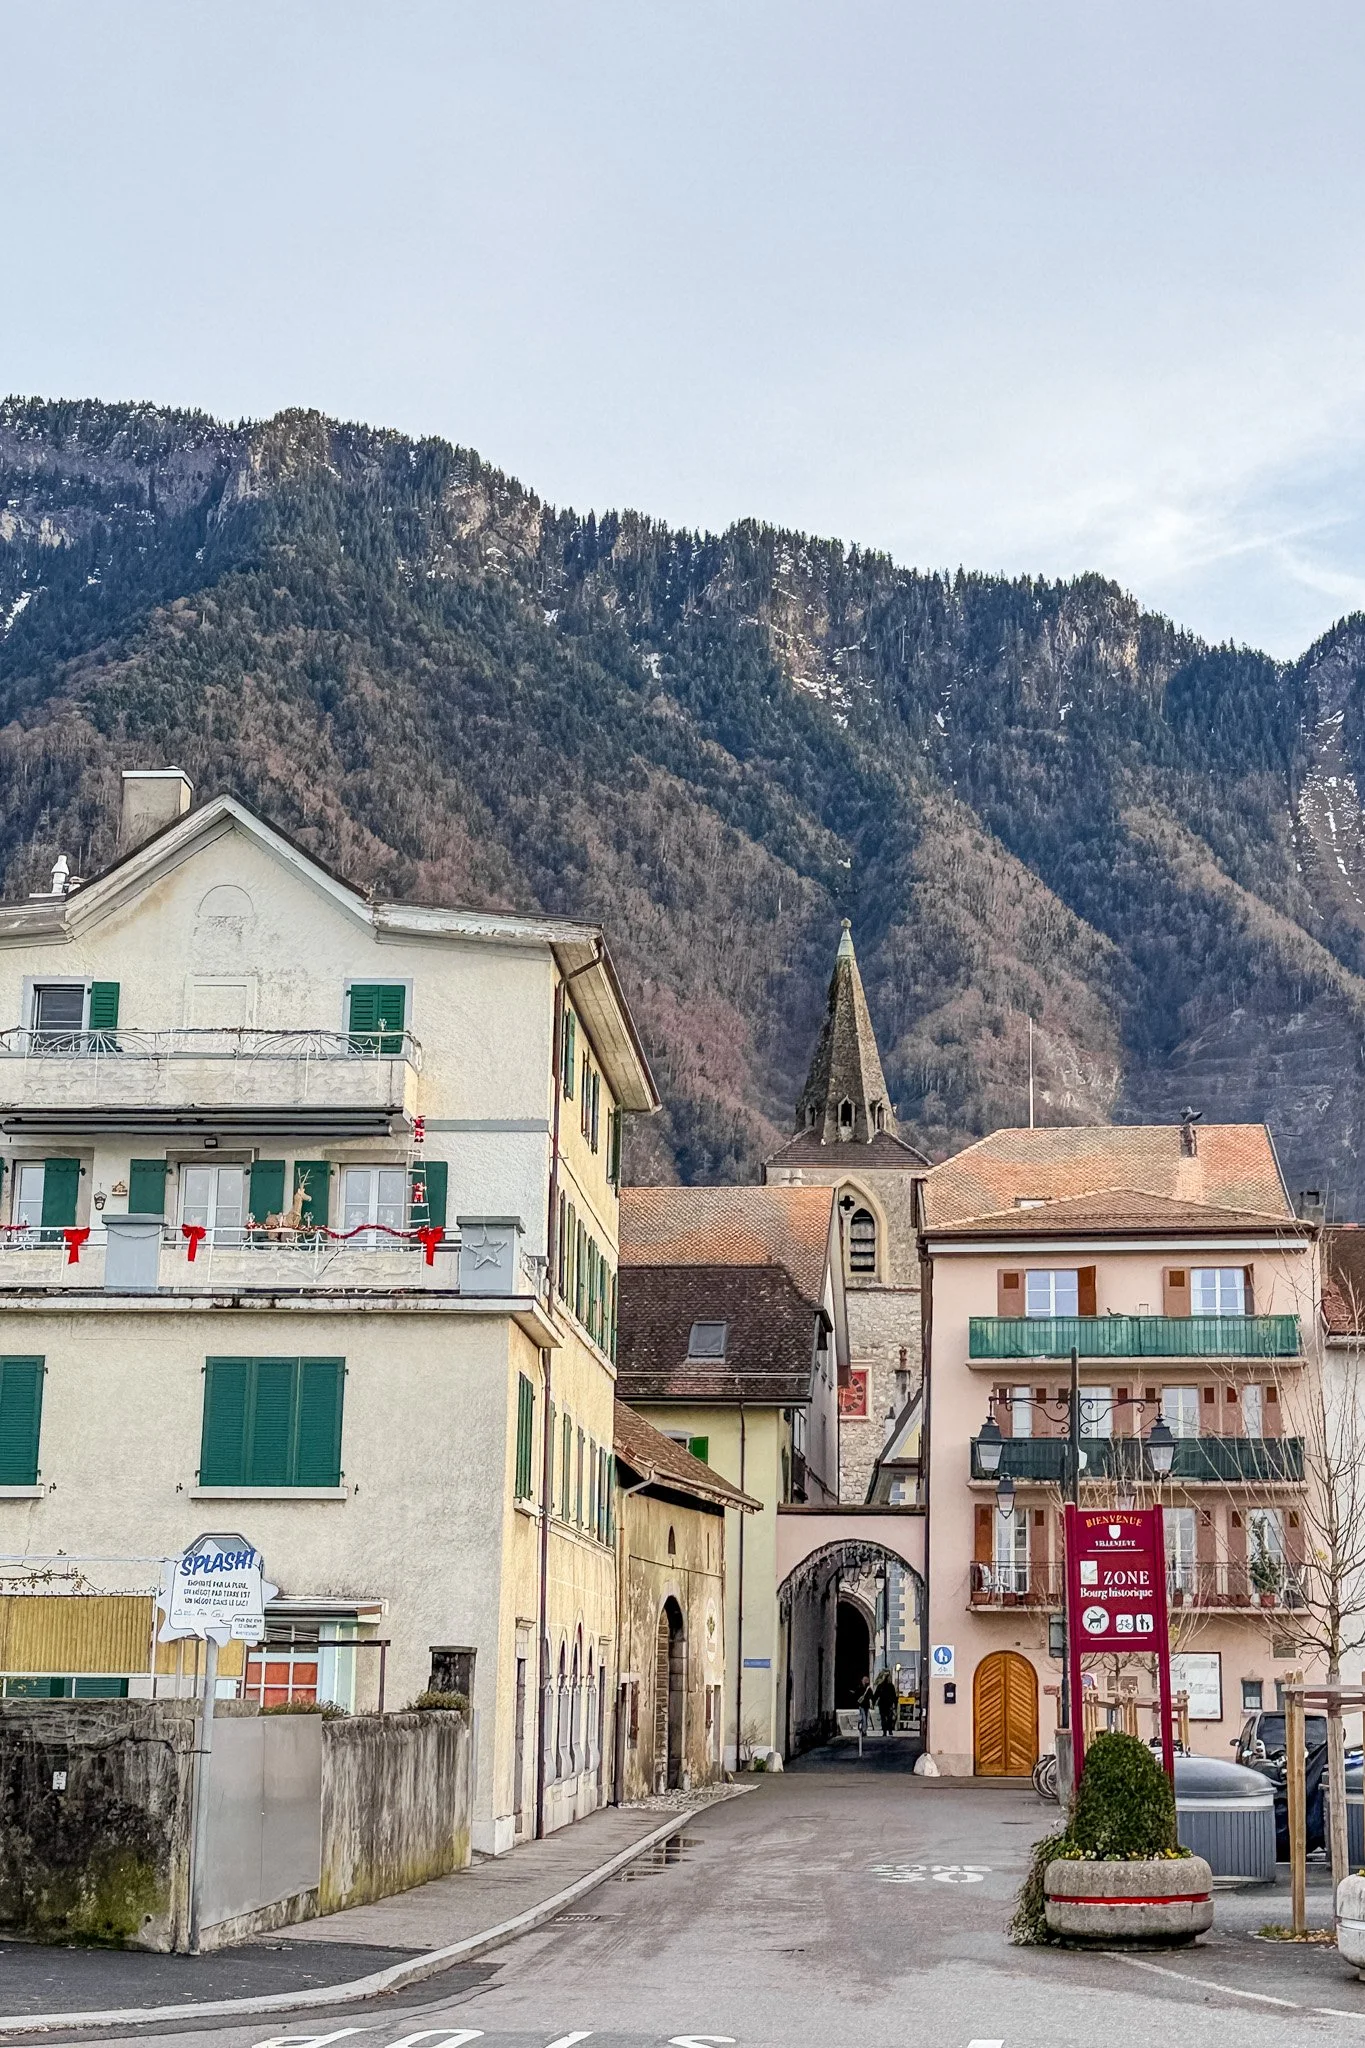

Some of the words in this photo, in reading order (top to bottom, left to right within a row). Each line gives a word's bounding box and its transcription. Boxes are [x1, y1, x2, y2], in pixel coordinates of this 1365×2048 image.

[1085, 1514, 1143, 1528] BIENVENUE
[180, 1547, 256, 1576] SPLASH!
[1103, 1570, 1150, 1586] ZONE
[1080, 1587, 1108, 1600] Bourg
[1109, 1586, 1154, 1600] historique
